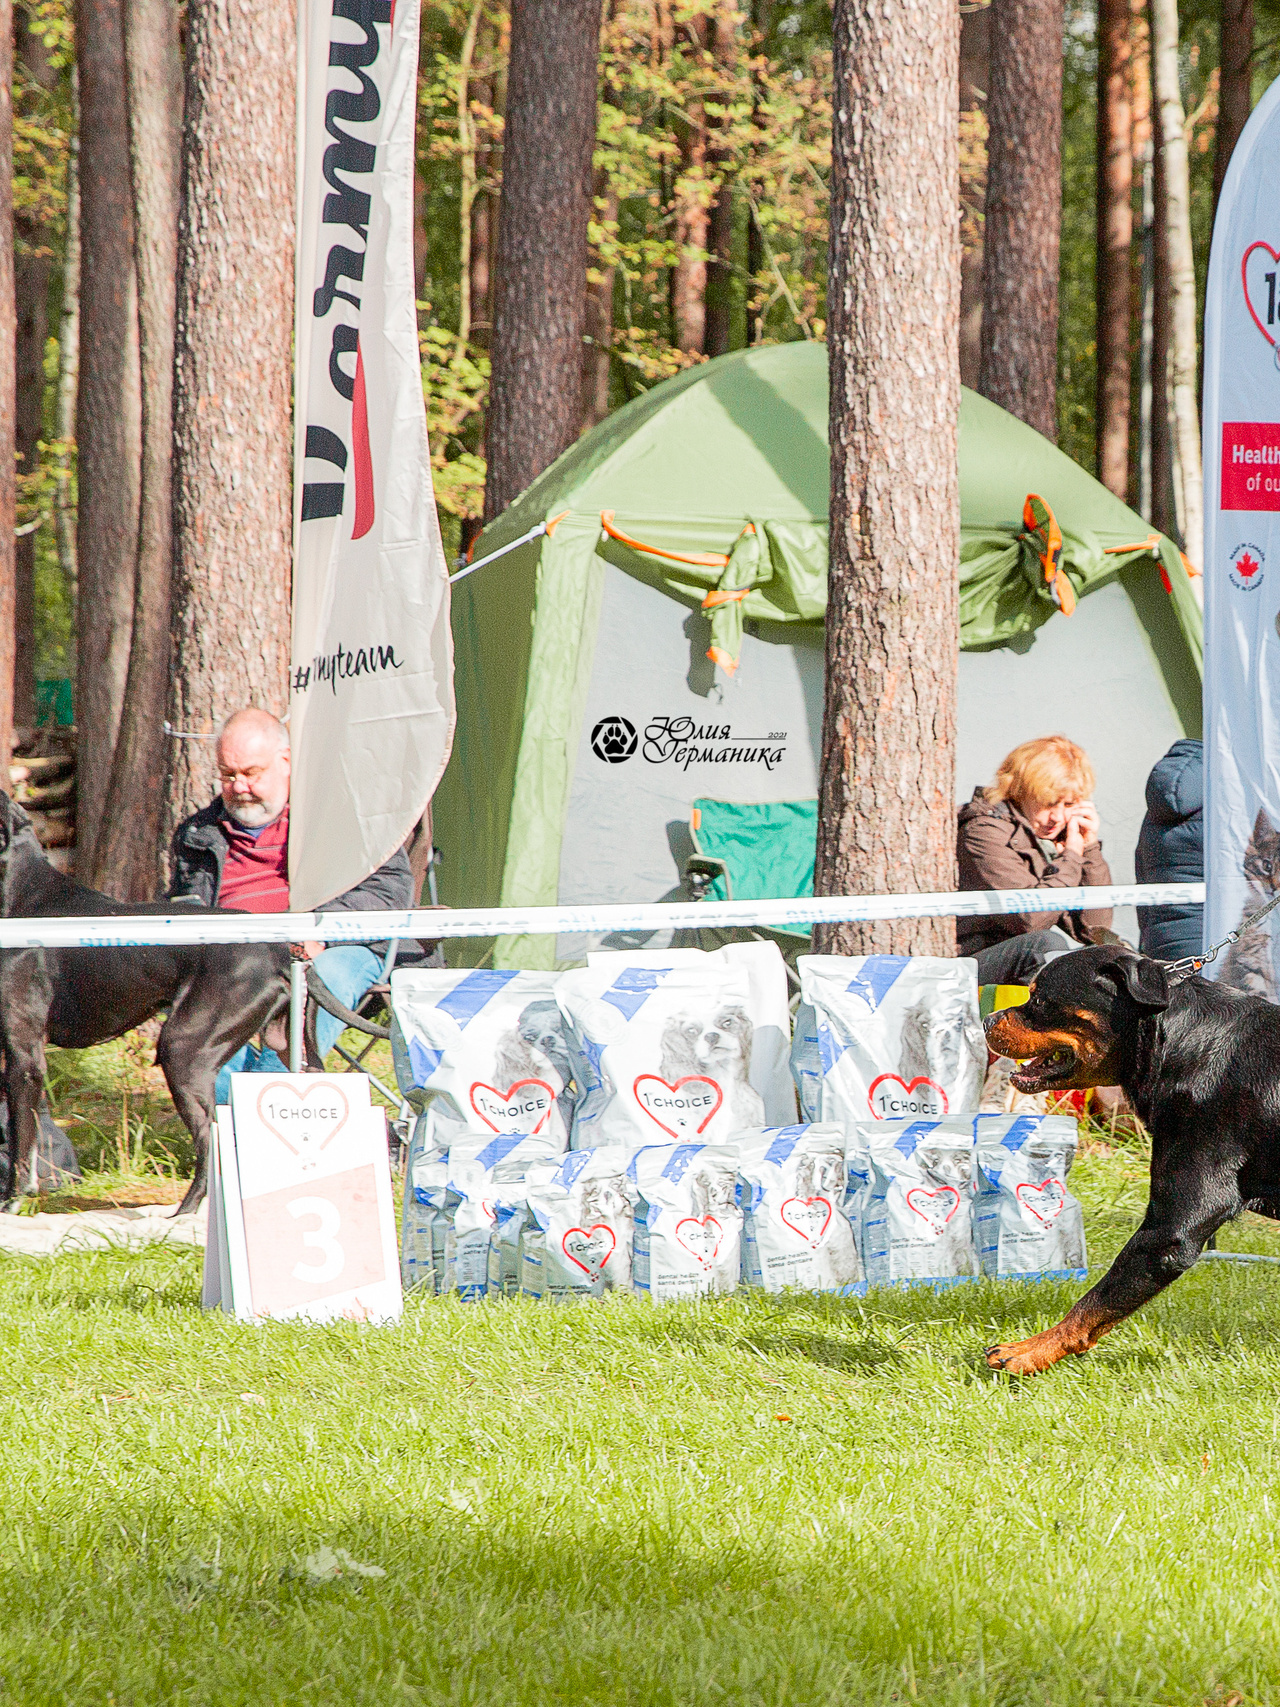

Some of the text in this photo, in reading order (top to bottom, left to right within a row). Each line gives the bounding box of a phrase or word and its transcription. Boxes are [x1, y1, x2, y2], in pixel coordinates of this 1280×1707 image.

[1246, 472, 1262, 491] of
[489, 1098, 547, 1118] CHOICE
[653, 1095, 713, 1109] CHOICE
[890, 1100, 938, 1115] CHOICE
[279, 1108, 338, 1119] CHOICE
[286, 1196, 345, 1284] 3
